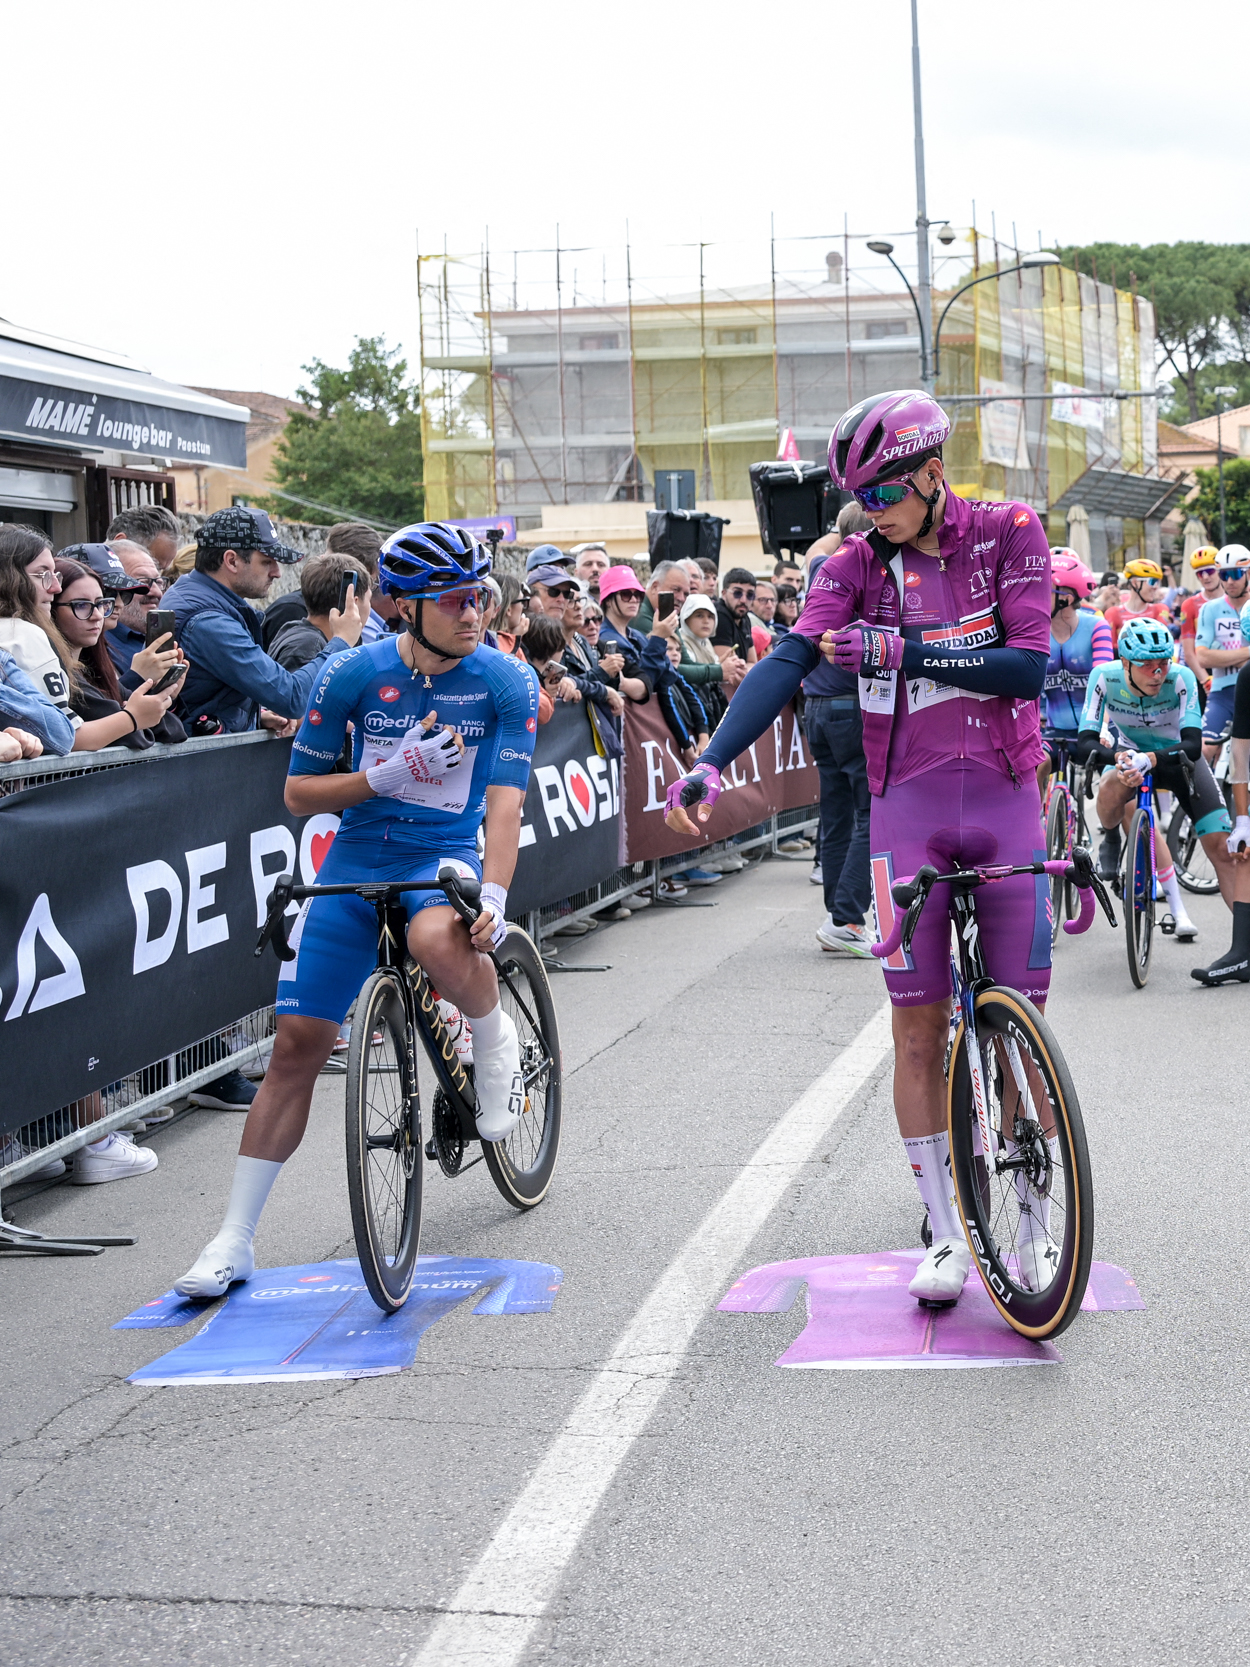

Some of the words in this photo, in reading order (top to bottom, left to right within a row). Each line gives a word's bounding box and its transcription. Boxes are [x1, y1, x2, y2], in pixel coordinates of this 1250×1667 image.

[881, 429, 945, 462] SPECIALIZED
[1218, 622, 1241, 631] NS
[923, 657, 984, 667] CASTELLI
[315, 649, 361, 705] CASTELLI
[503, 655, 536, 711] CASTELLI
[475, 692, 488, 701] Sport
[126, 854, 230, 976] DE
[1208, 960, 1249, 977] GAERNE
